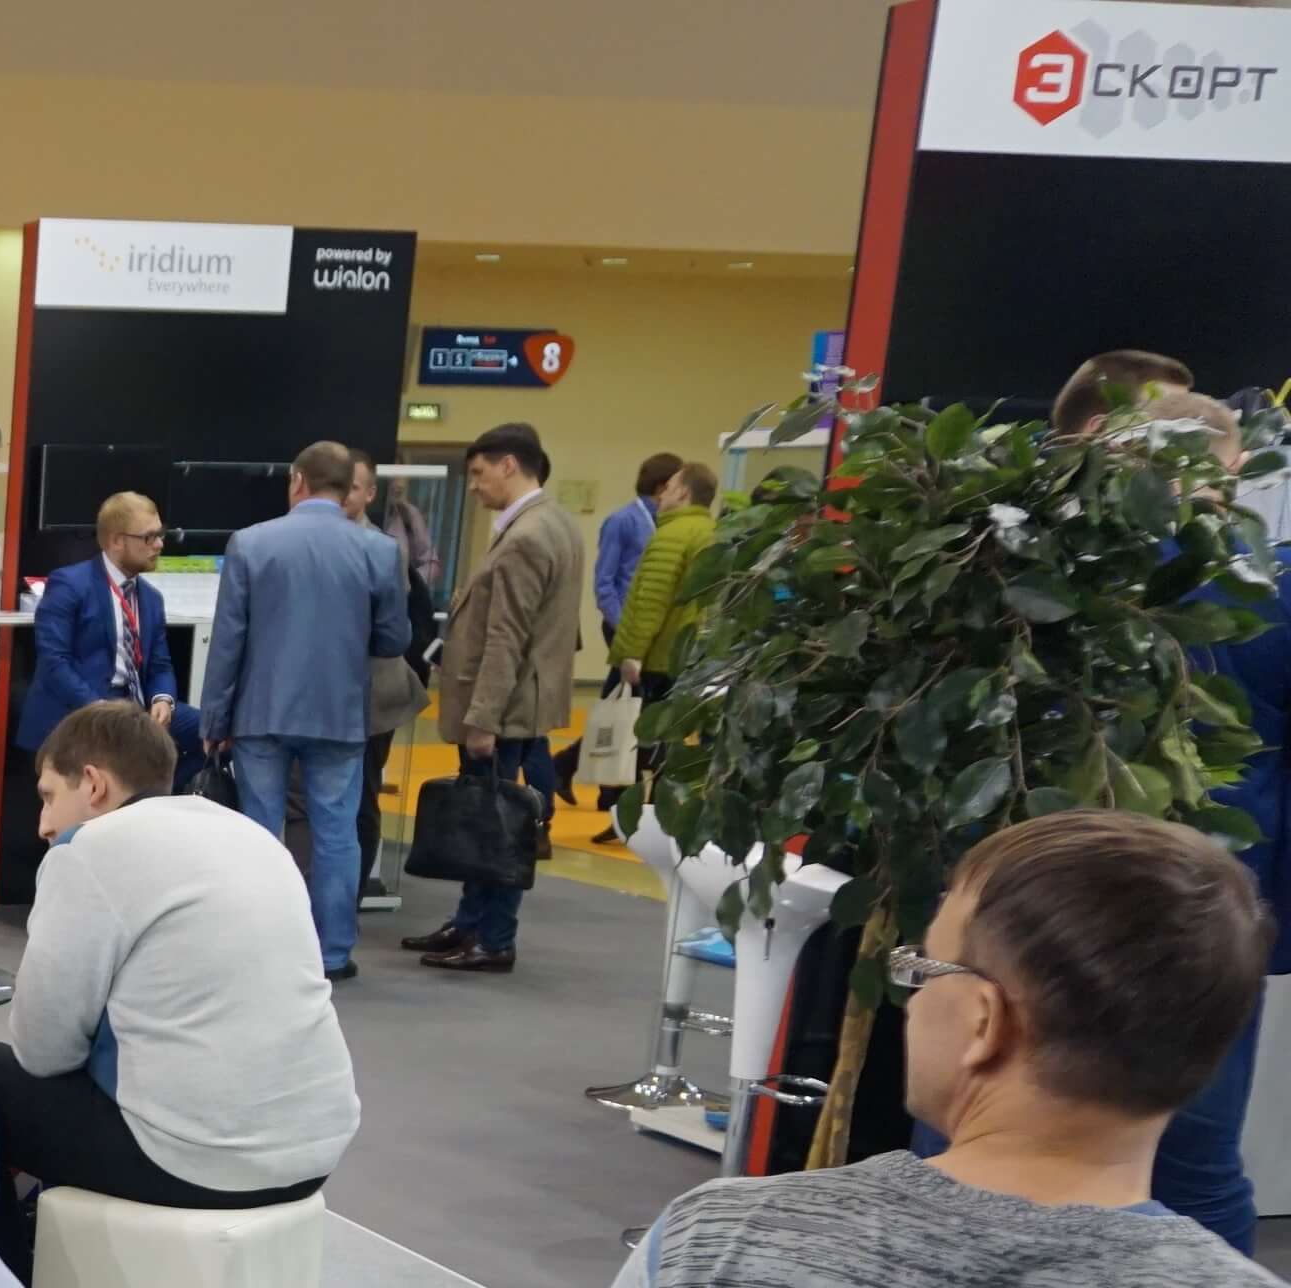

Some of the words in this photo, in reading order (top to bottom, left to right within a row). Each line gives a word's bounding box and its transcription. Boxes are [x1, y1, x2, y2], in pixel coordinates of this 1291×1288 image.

[128, 244, 232, 275] iridium
[316, 247, 373, 262] powered
[375, 247, 392, 267] by
[147, 277, 230, 296] Everywhere
[314, 265, 390, 291] wialon
[542, 342, 561, 373] 8
